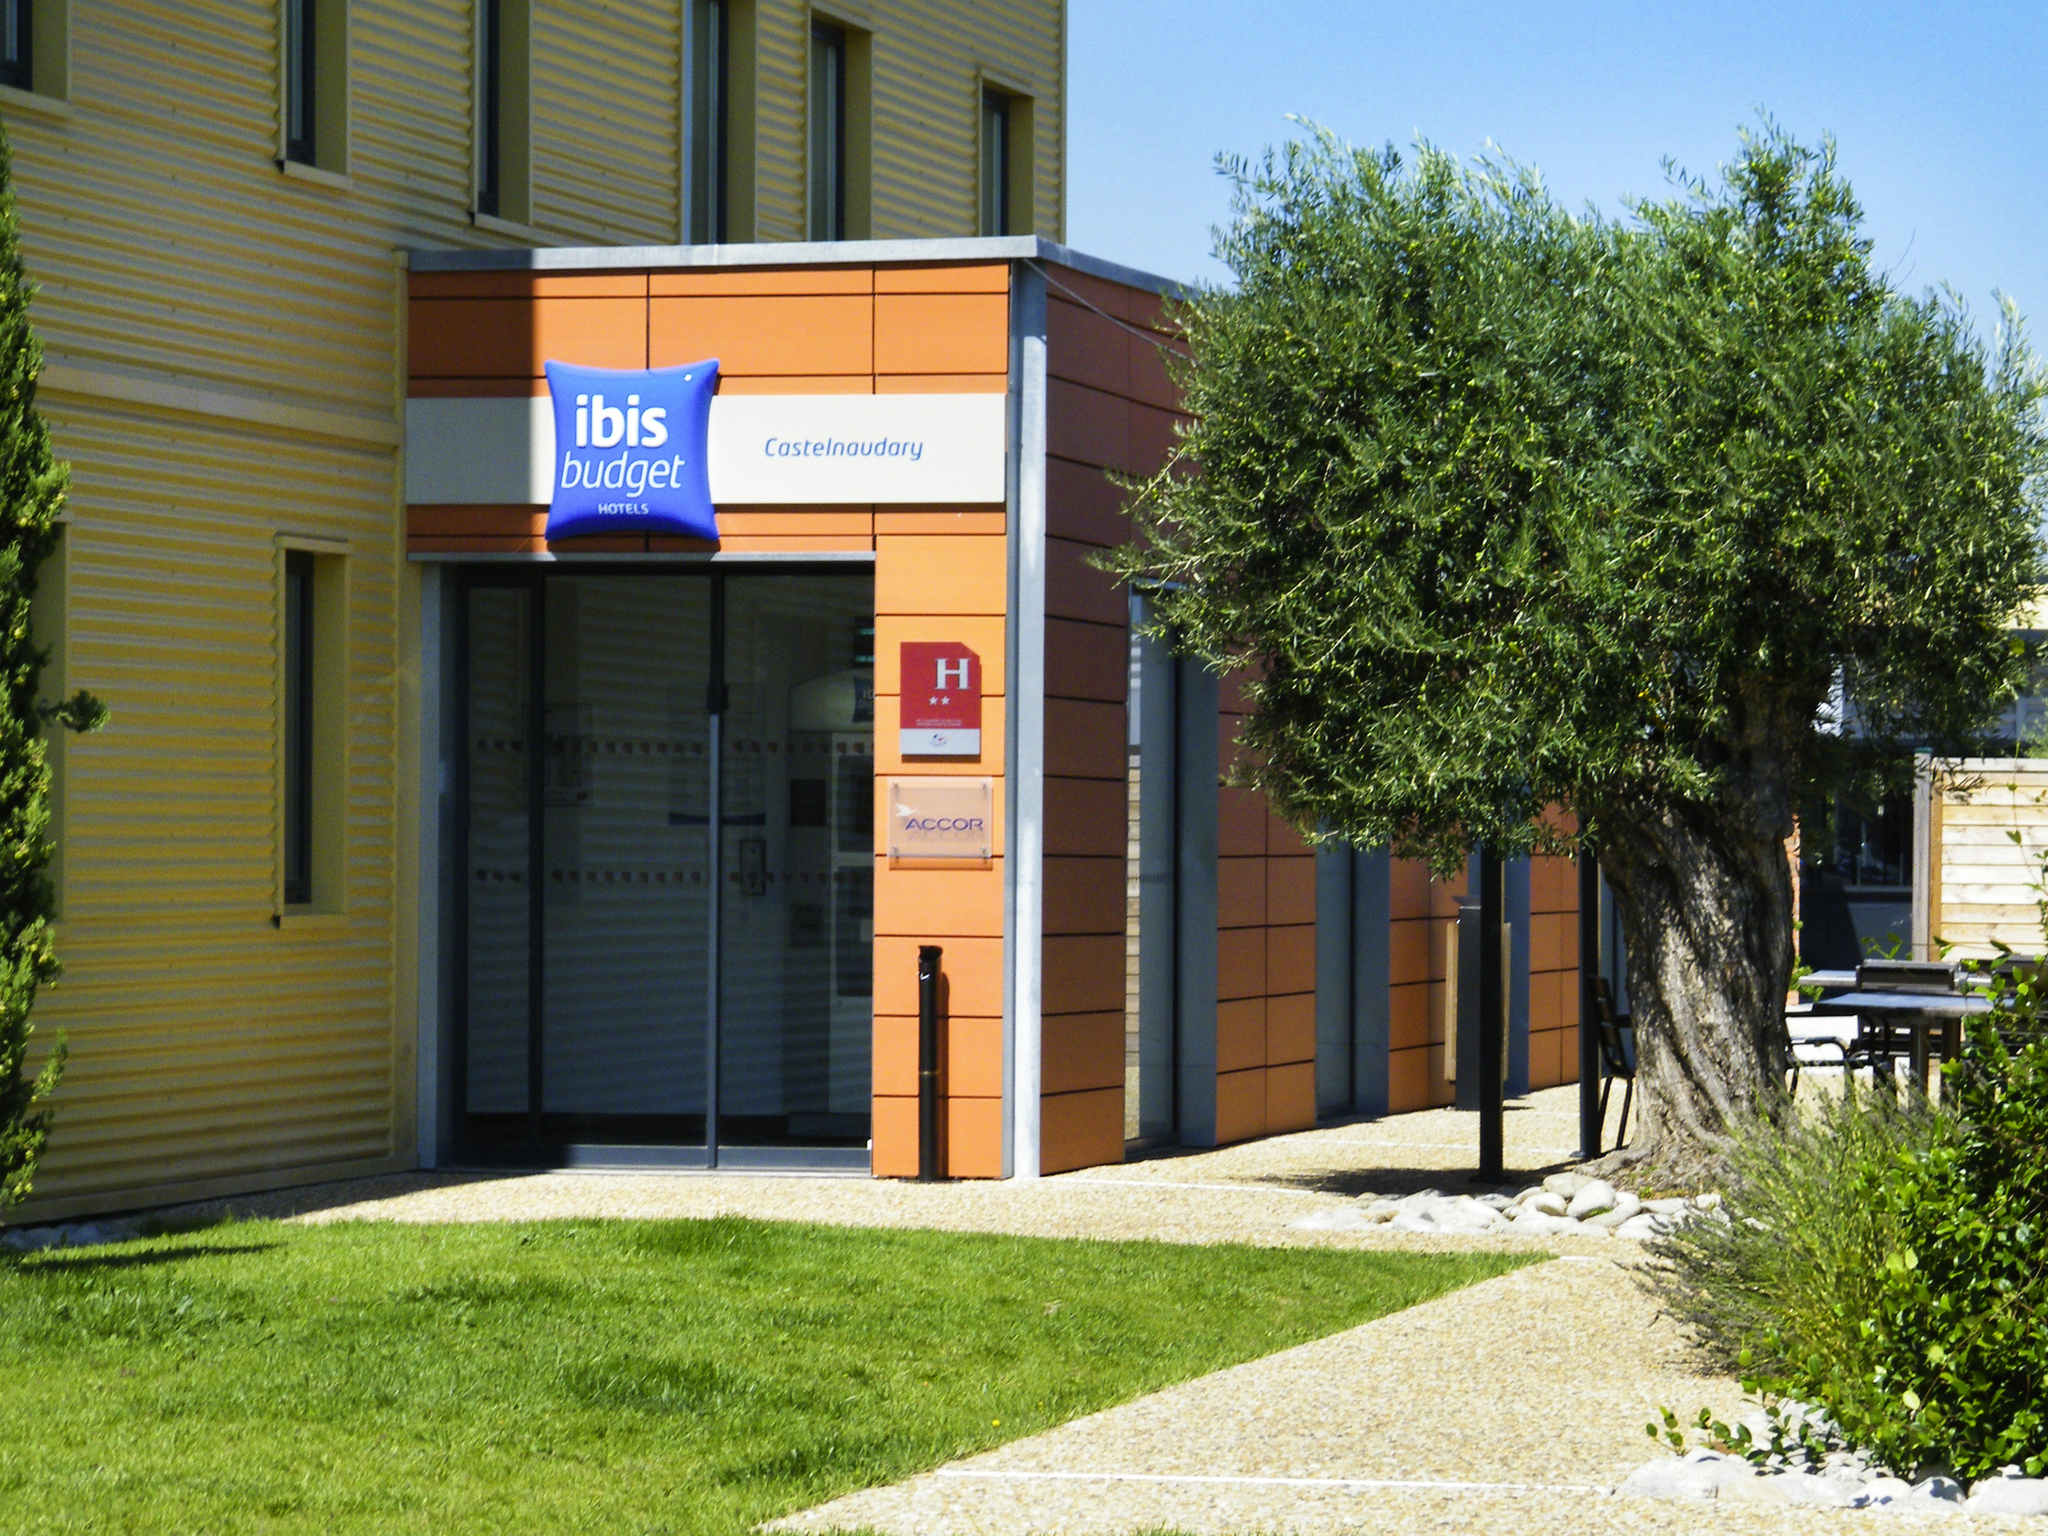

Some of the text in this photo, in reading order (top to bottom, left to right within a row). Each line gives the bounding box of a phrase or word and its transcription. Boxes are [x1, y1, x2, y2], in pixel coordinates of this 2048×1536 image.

[575, 394, 669, 448] ibis
[764, 437, 924, 461] Castelnaudary
[560, 451, 686, 498] budget
[598, 503, 650, 516] HOTELS
[935, 658, 971, 690] H
[904, 817, 985, 832] ACCOR
